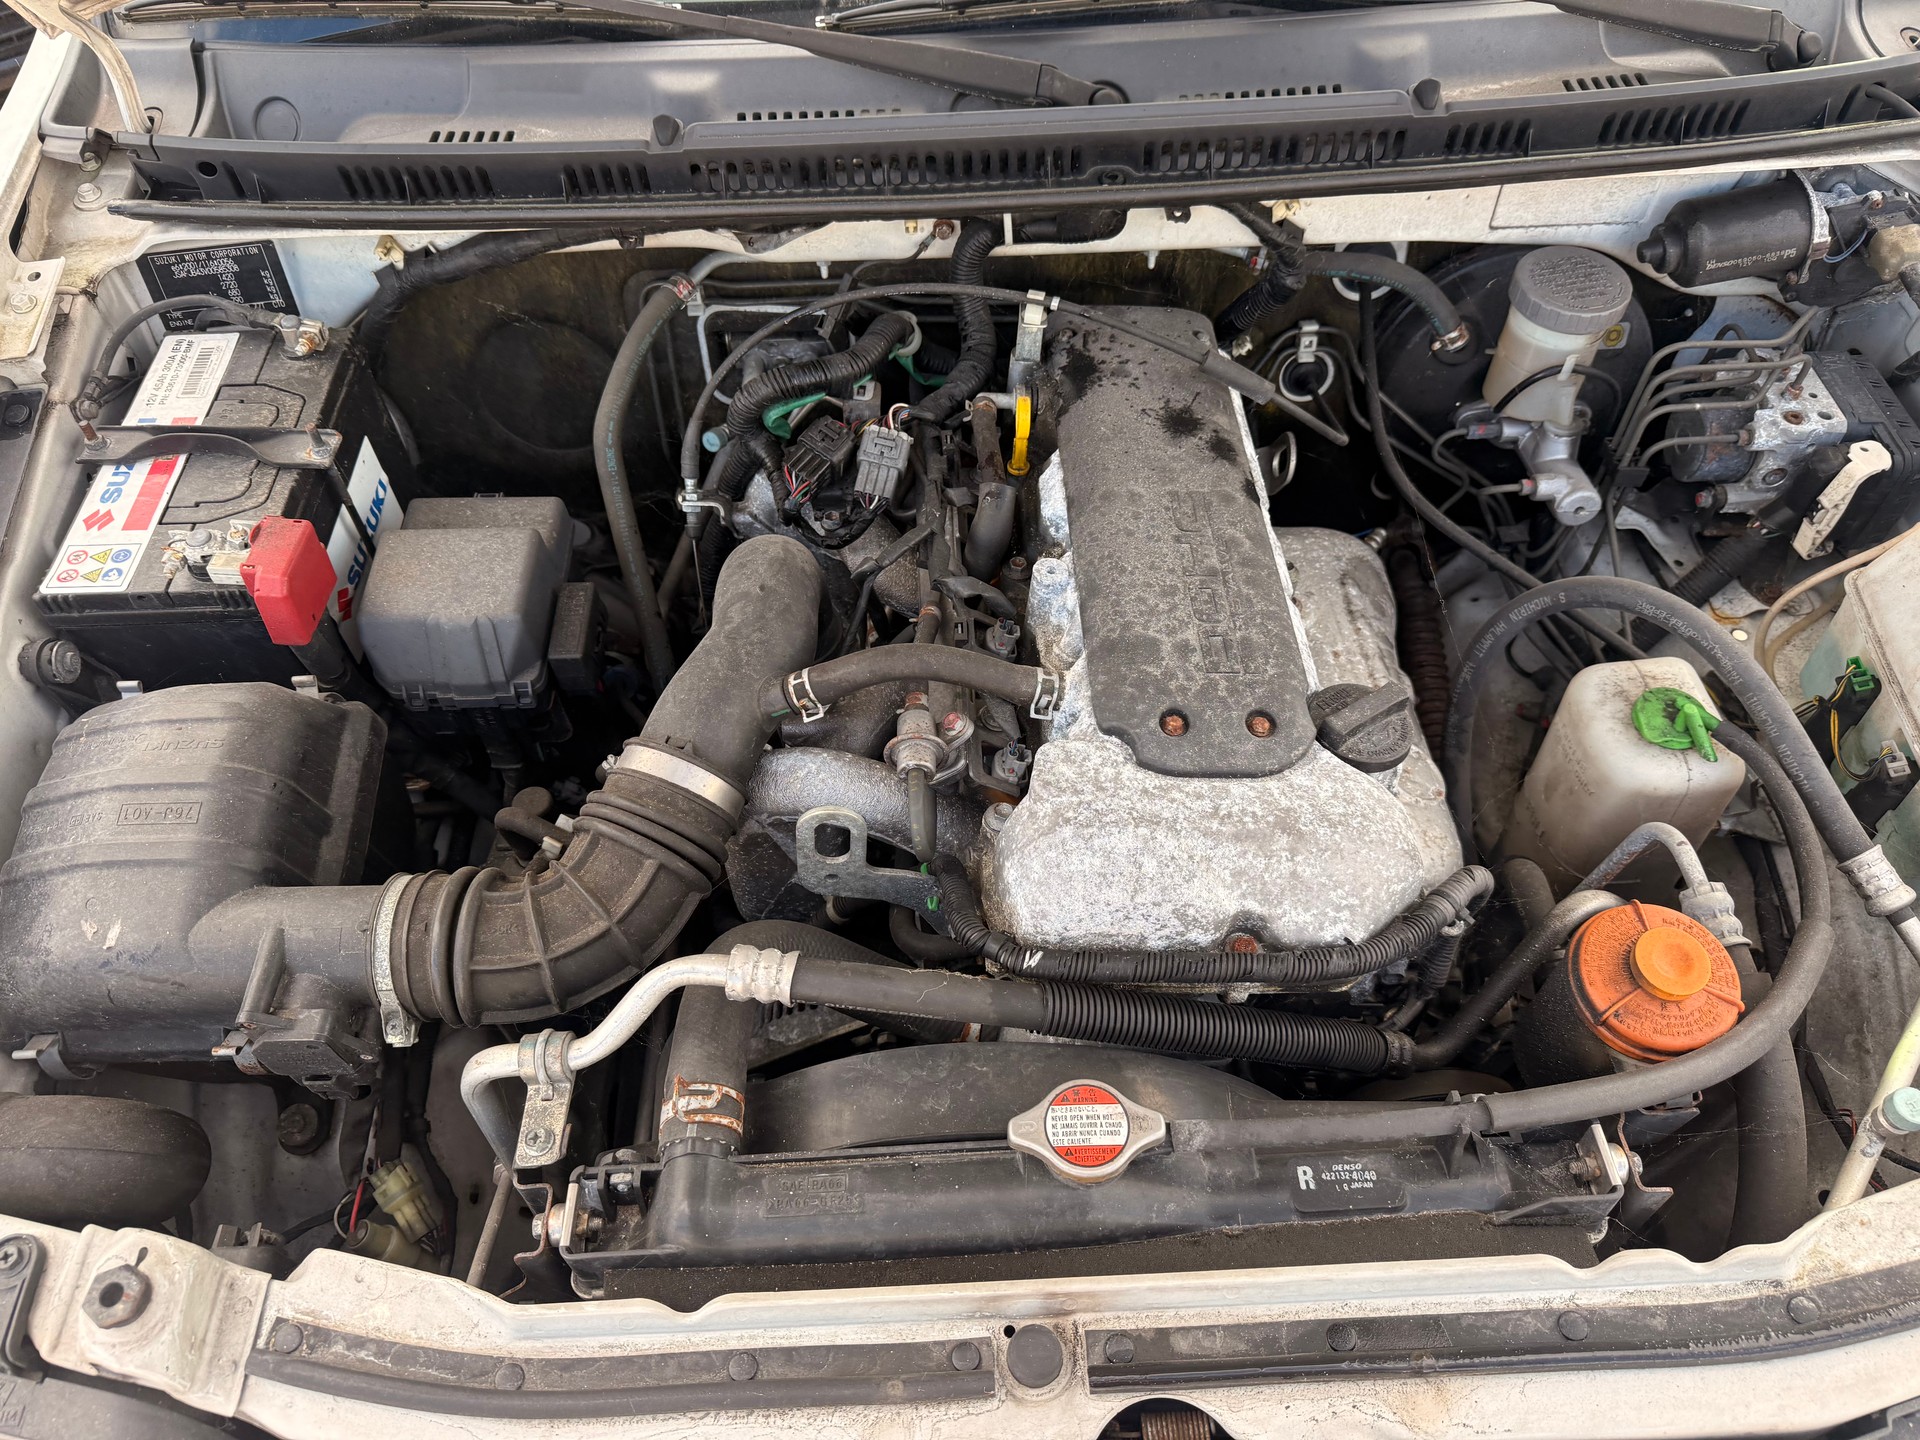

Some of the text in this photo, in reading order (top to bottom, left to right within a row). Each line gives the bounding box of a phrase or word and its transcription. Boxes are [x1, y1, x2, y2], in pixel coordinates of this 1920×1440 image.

[154, 246, 259, 265] SUZUKI MOTOR CORPORATION
[218, 269, 271, 281] 1420 kg
[220, 277, 273, 290] 2720 kg
[228, 288, 241, 297] 680
[266, 285, 276, 294] kg
[268, 293, 279, 301] kg
[169, 319, 194, 328] ENGINE
[146, 338, 187, 407] 12V 45Ah 300A (EN)
[1508, 595, 1553, 623] NICHIRIN
[1316, 687, 1353, 711] ENGINE
[145, 737, 225, 752] SUZUKI
[1776, 743, 1812, 794] NICHIRIN
[122, 805, 194, 821] 76J-A01
[1051, 1114, 1068, 1122] NEVER
[1085, 1113, 1101, 1121] WHEN
[1080, 1121, 1099, 1129] OUVRIR
[1052, 1130, 1060, 1138] NO
[1079, 1129, 1098, 1137] NUNCA
[1099, 1129, 1121, 1137] CUANDO
[1052, 1138, 1066, 1146] ESTE
[1074, 1147, 1117, 1155] AVERTISSEMENT
[1074, 1155, 1107, 1163] ADVERTENCIA
[1332, 1162, 1363, 1171] DENSO
[1296, 1165, 1317, 1190] R
[781, 1180, 805, 1192] SAE
[1349, 1181, 1374, 1189] JAPAN
